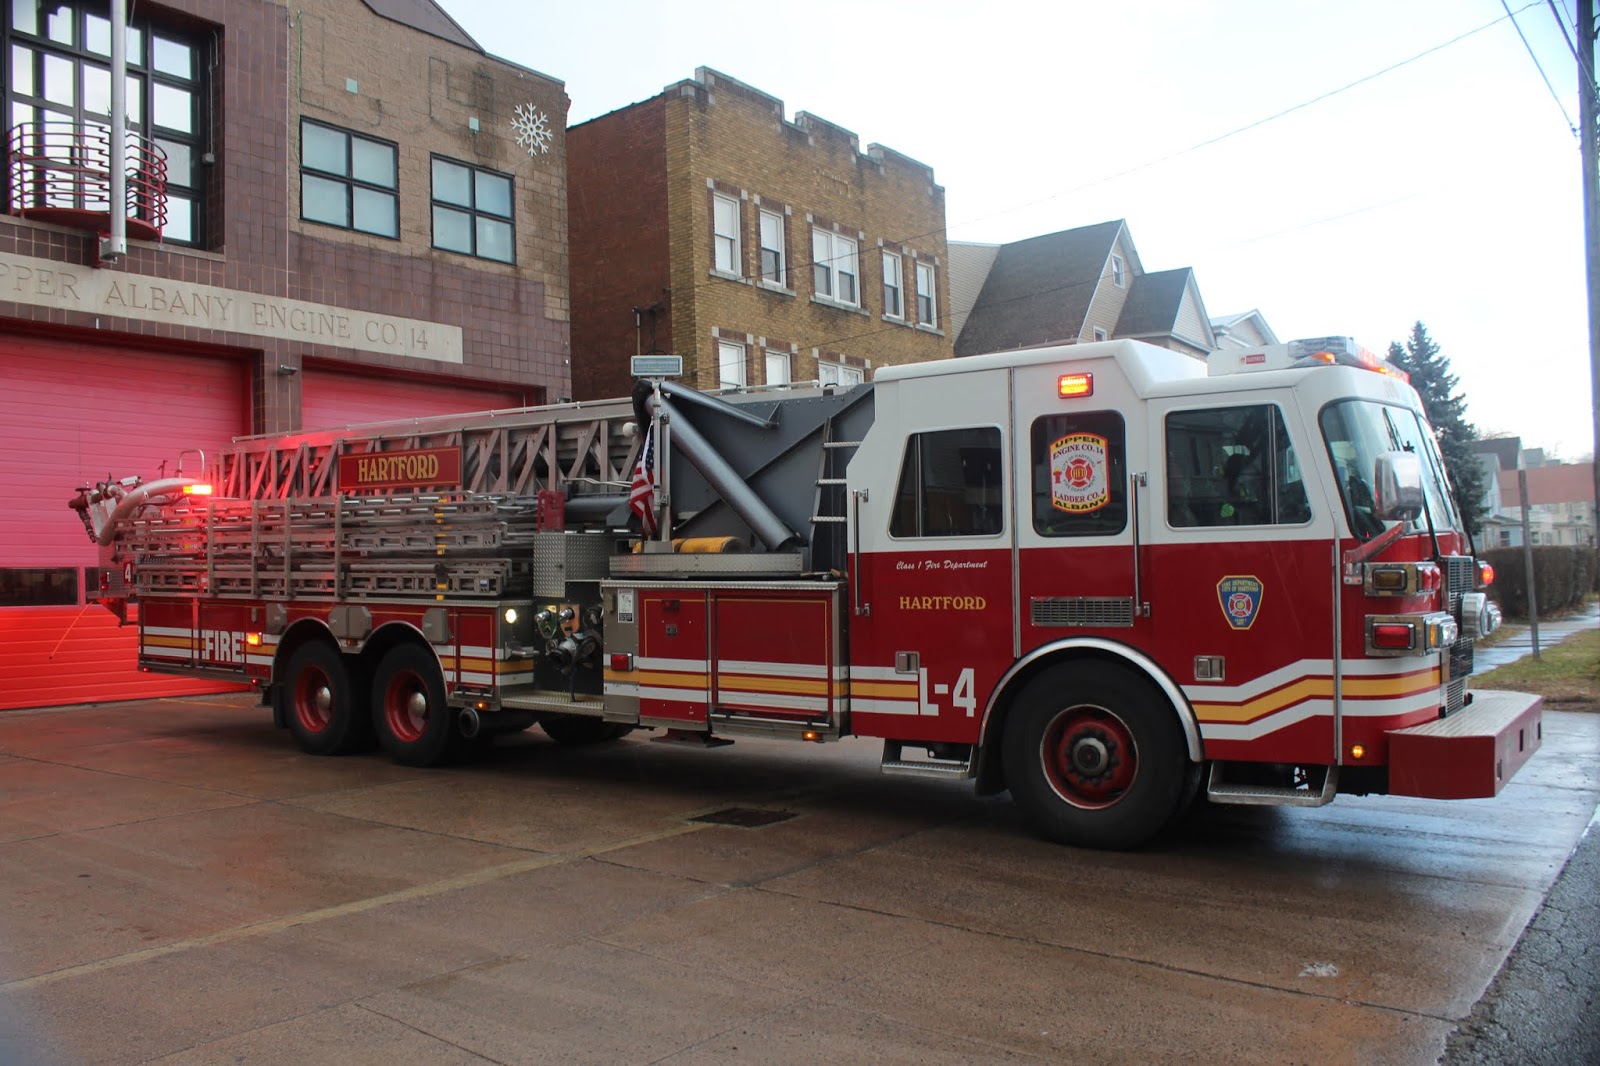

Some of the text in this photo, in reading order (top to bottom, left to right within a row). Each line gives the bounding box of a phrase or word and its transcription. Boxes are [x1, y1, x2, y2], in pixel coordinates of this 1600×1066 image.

[105, 280, 233, 320] ALBANY
[251, 302, 351, 338] ENGINE
[411, 327, 428, 350] 14
[1055, 436, 1100, 448] UPPER
[1053, 444, 1081, 460] ENGINE
[1081, 444, 1095, 453] CO.
[358, 454, 439, 482] HARTFORD
[1054, 491, 1086, 503] LADDER
[1086, 491, 1100, 501] CO.
[1054, 495, 1107, 510] ALBANY
[124, 563, 132, 582] 4
[896, 561, 915, 570] Class
[924, 560, 941, 571] Fire
[943, 560, 988, 570] Department
[899, 596, 986, 610] HARTFORD
[205, 629, 243, 663] FIRE
[919, 667, 977, 718] L-4
